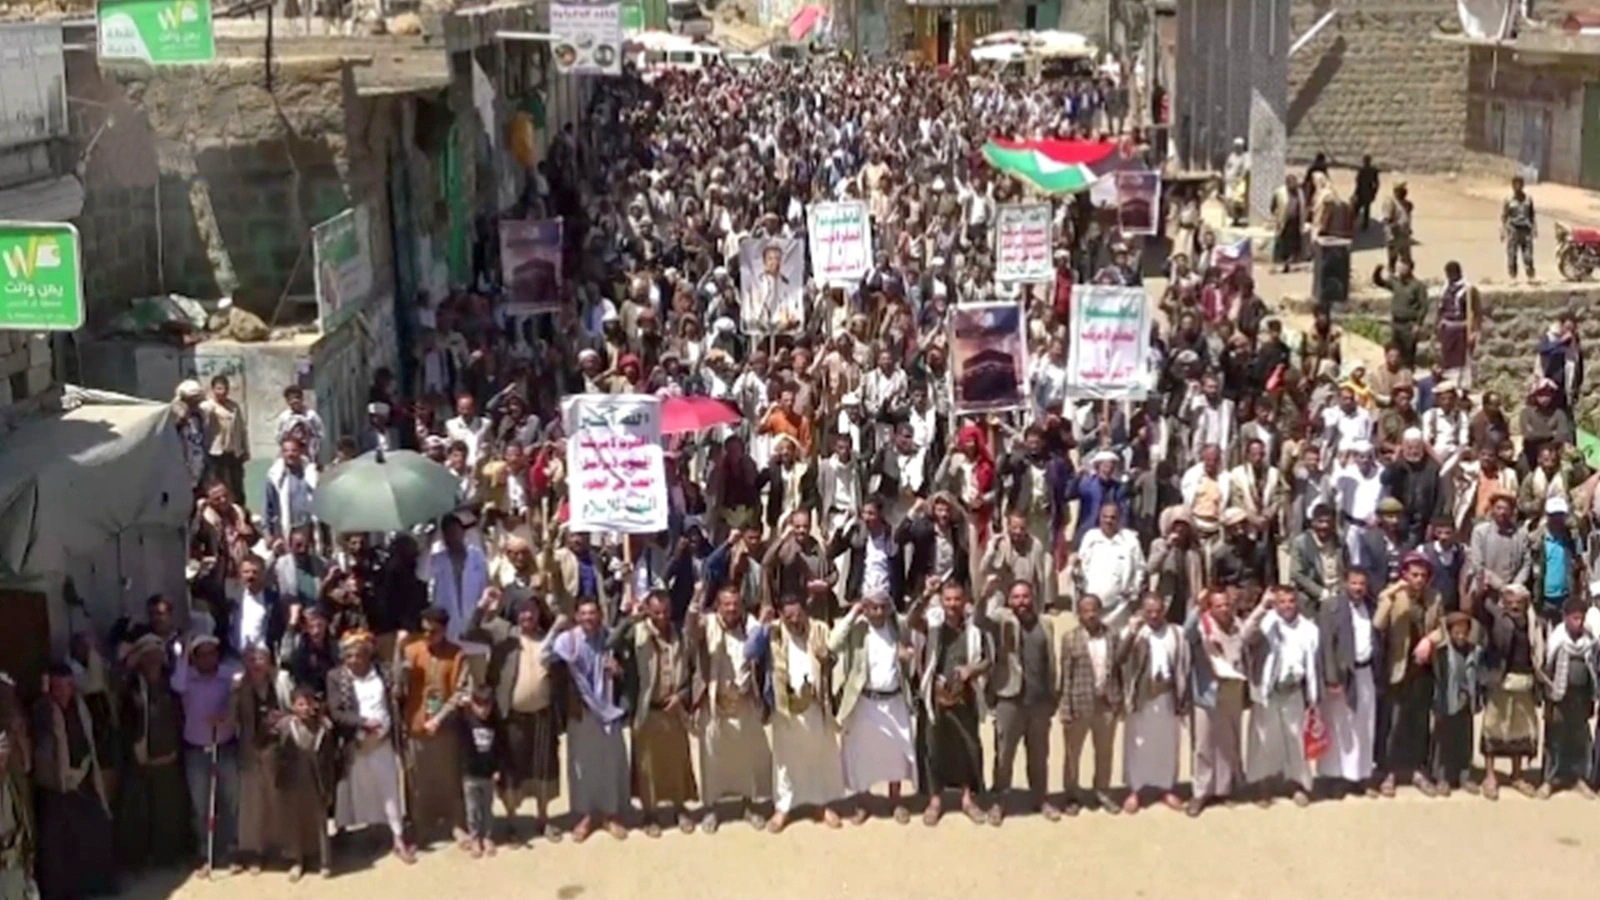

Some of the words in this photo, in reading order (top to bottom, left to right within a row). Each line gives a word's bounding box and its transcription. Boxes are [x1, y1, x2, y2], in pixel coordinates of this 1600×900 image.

[4, 280, 36, 298] والت
[38, 283, 64, 298] يمن
[580, 406, 617, 430] أكبر
[619, 412, 651, 427] الله
